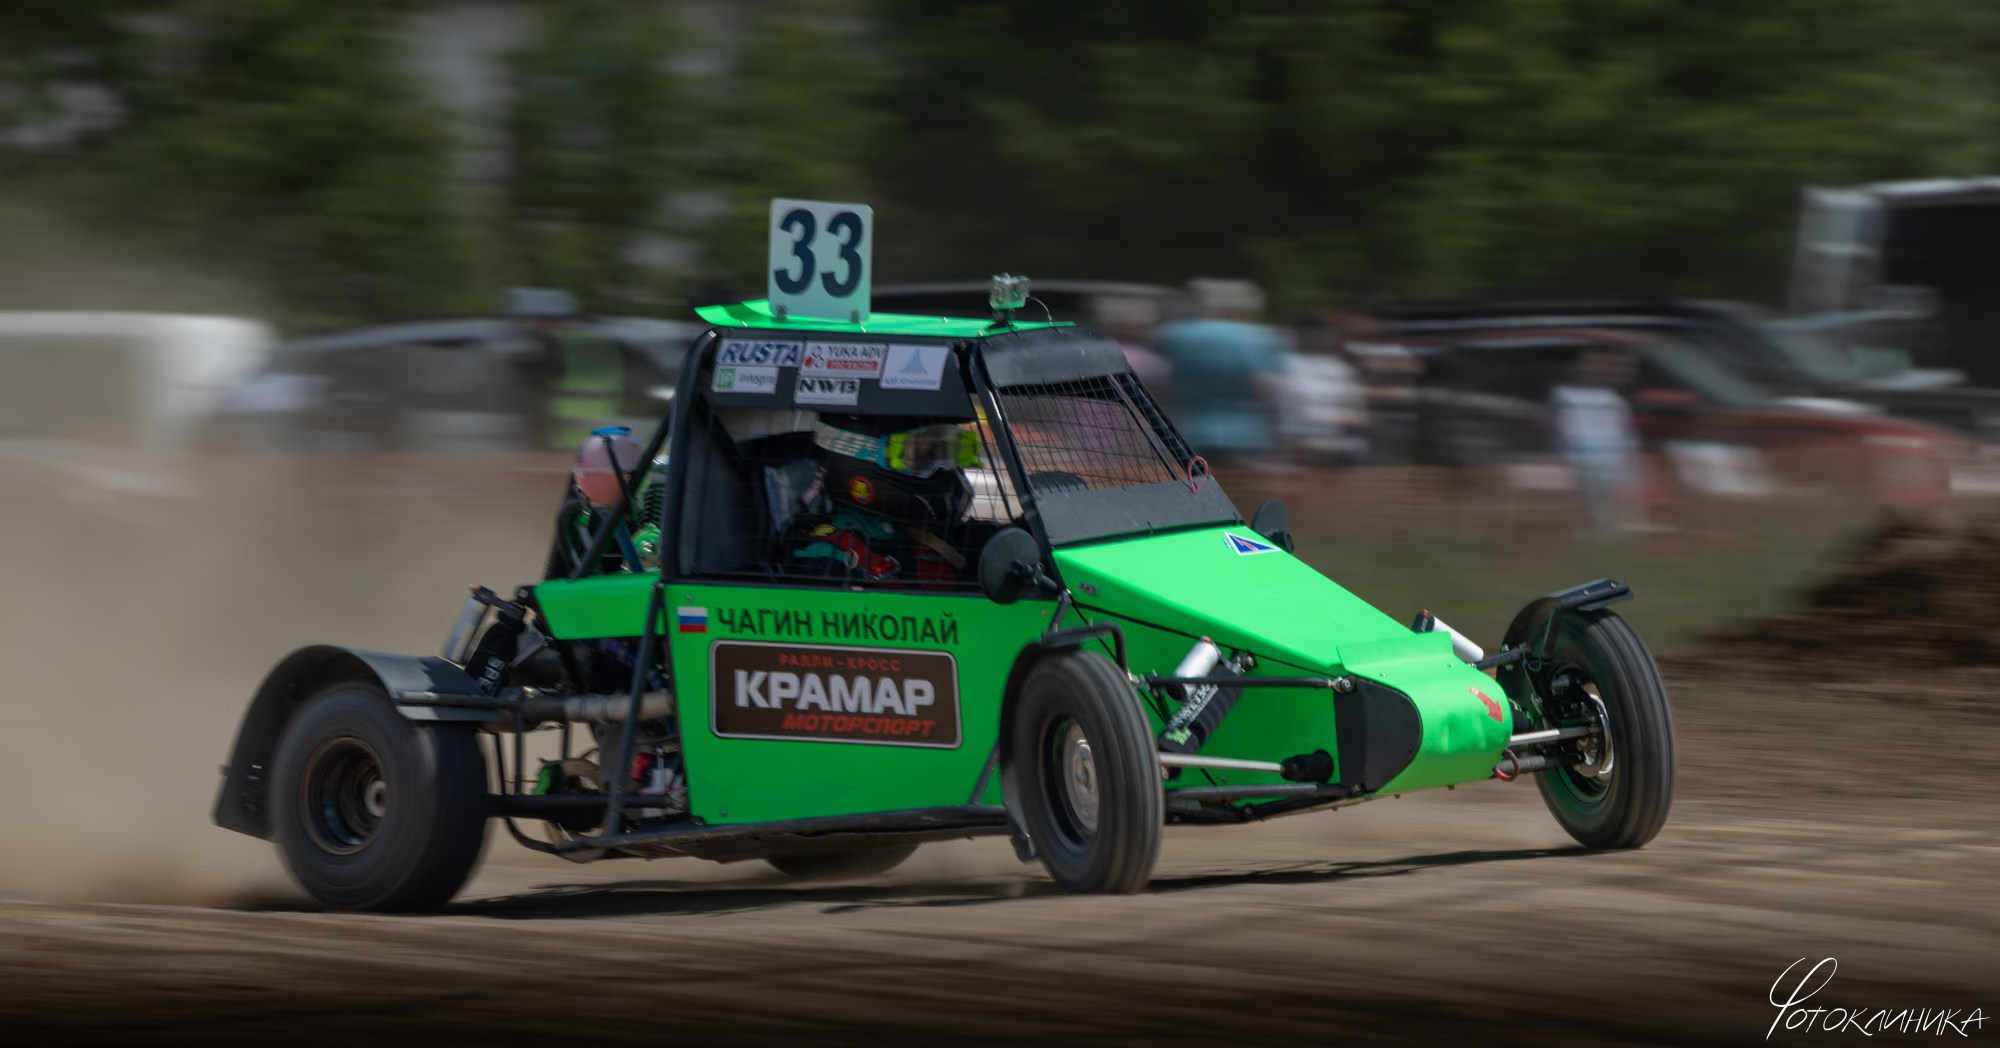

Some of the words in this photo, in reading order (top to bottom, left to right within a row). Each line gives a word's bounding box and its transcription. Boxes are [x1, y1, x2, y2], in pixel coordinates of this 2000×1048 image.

[774, 207, 864, 298] 33
[721, 342, 799, 365] RUSTA
[717, 607, 813, 637] ЧАГИН
[822, 610, 959, 645] НИКОЛАЙ
[734, 669, 936, 716] КРАМАР
[781, 712, 936, 737] МОТОРСПОРТ
